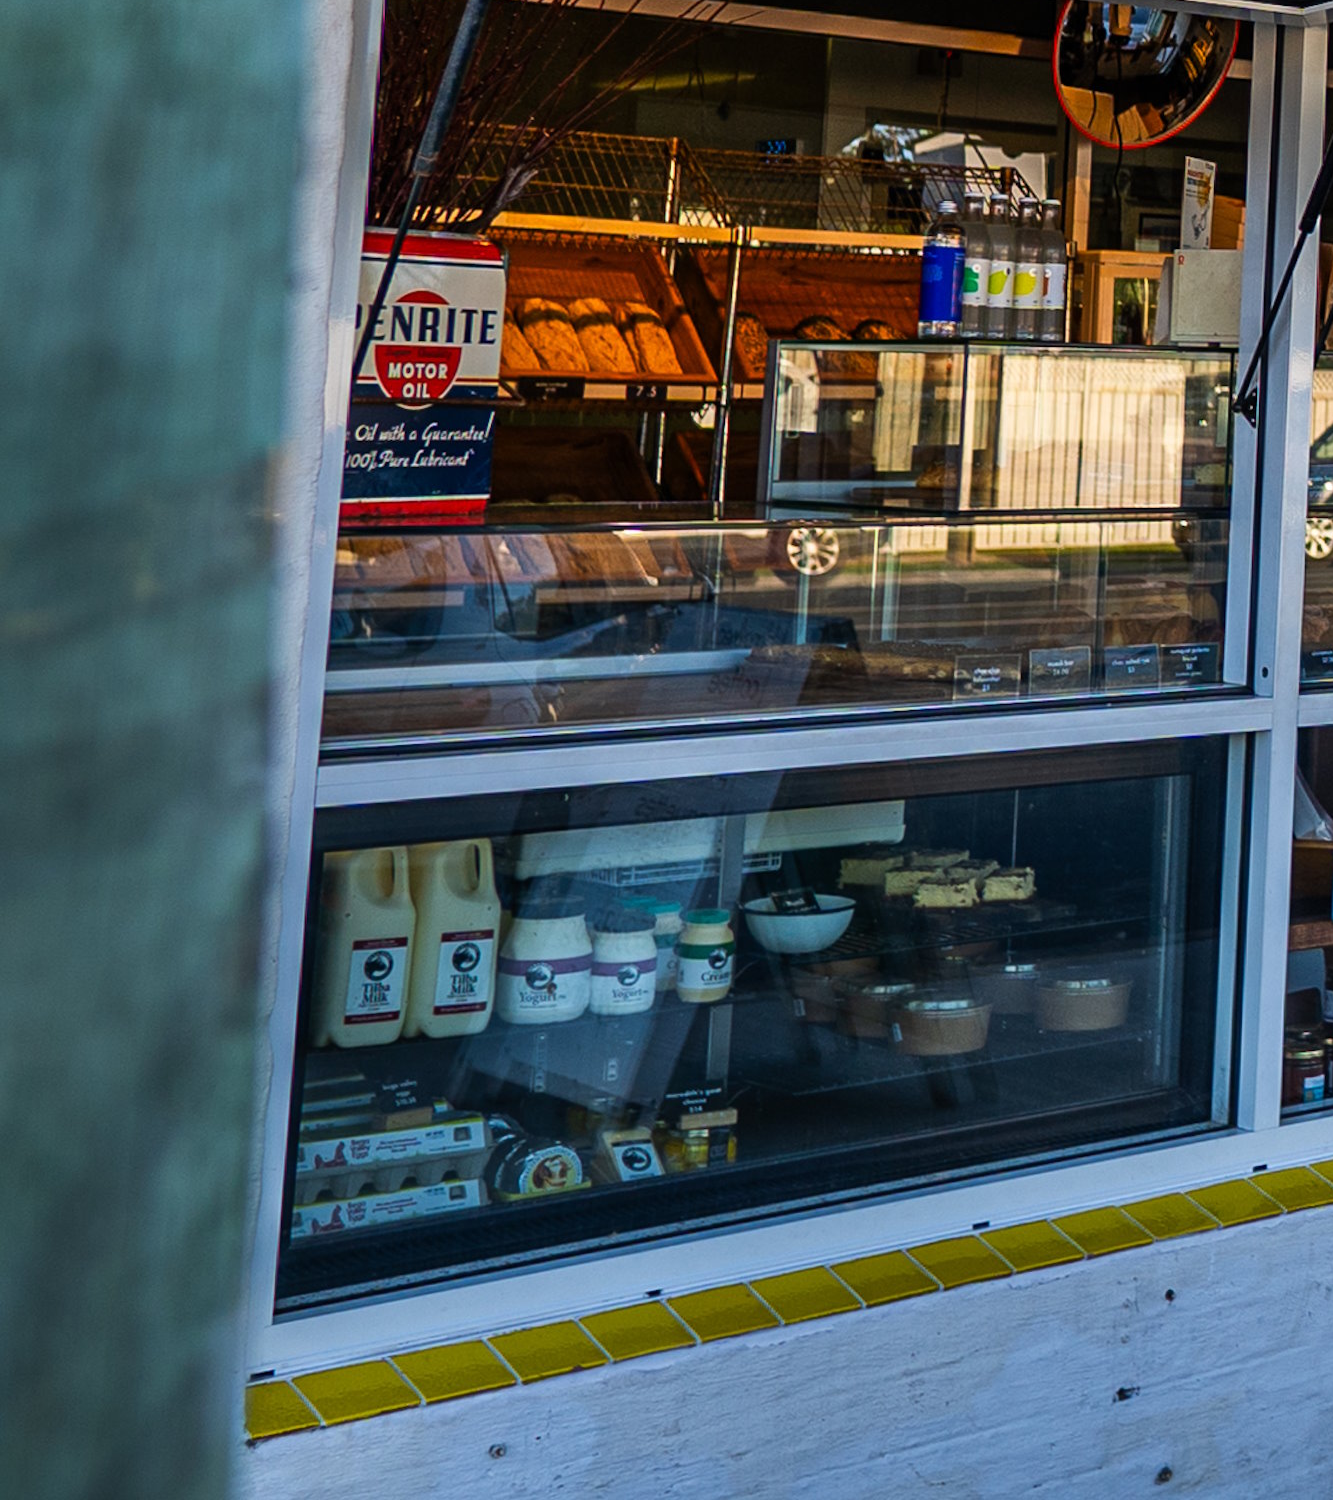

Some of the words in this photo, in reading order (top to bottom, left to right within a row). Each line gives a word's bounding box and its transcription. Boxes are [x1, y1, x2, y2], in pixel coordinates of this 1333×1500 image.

[388, 362, 448, 379] MOTOR
[402, 383, 431, 399] OIL
[355, 422, 379, 441] Oil
[379, 422, 406, 441] with
[409, 431, 417, 441] a
[422, 411, 495, 447] Guarantee!
[378, 450, 410, 468] Pure
[362, 991, 388, 1002] Milk
[450, 983, 476, 994] Milk
